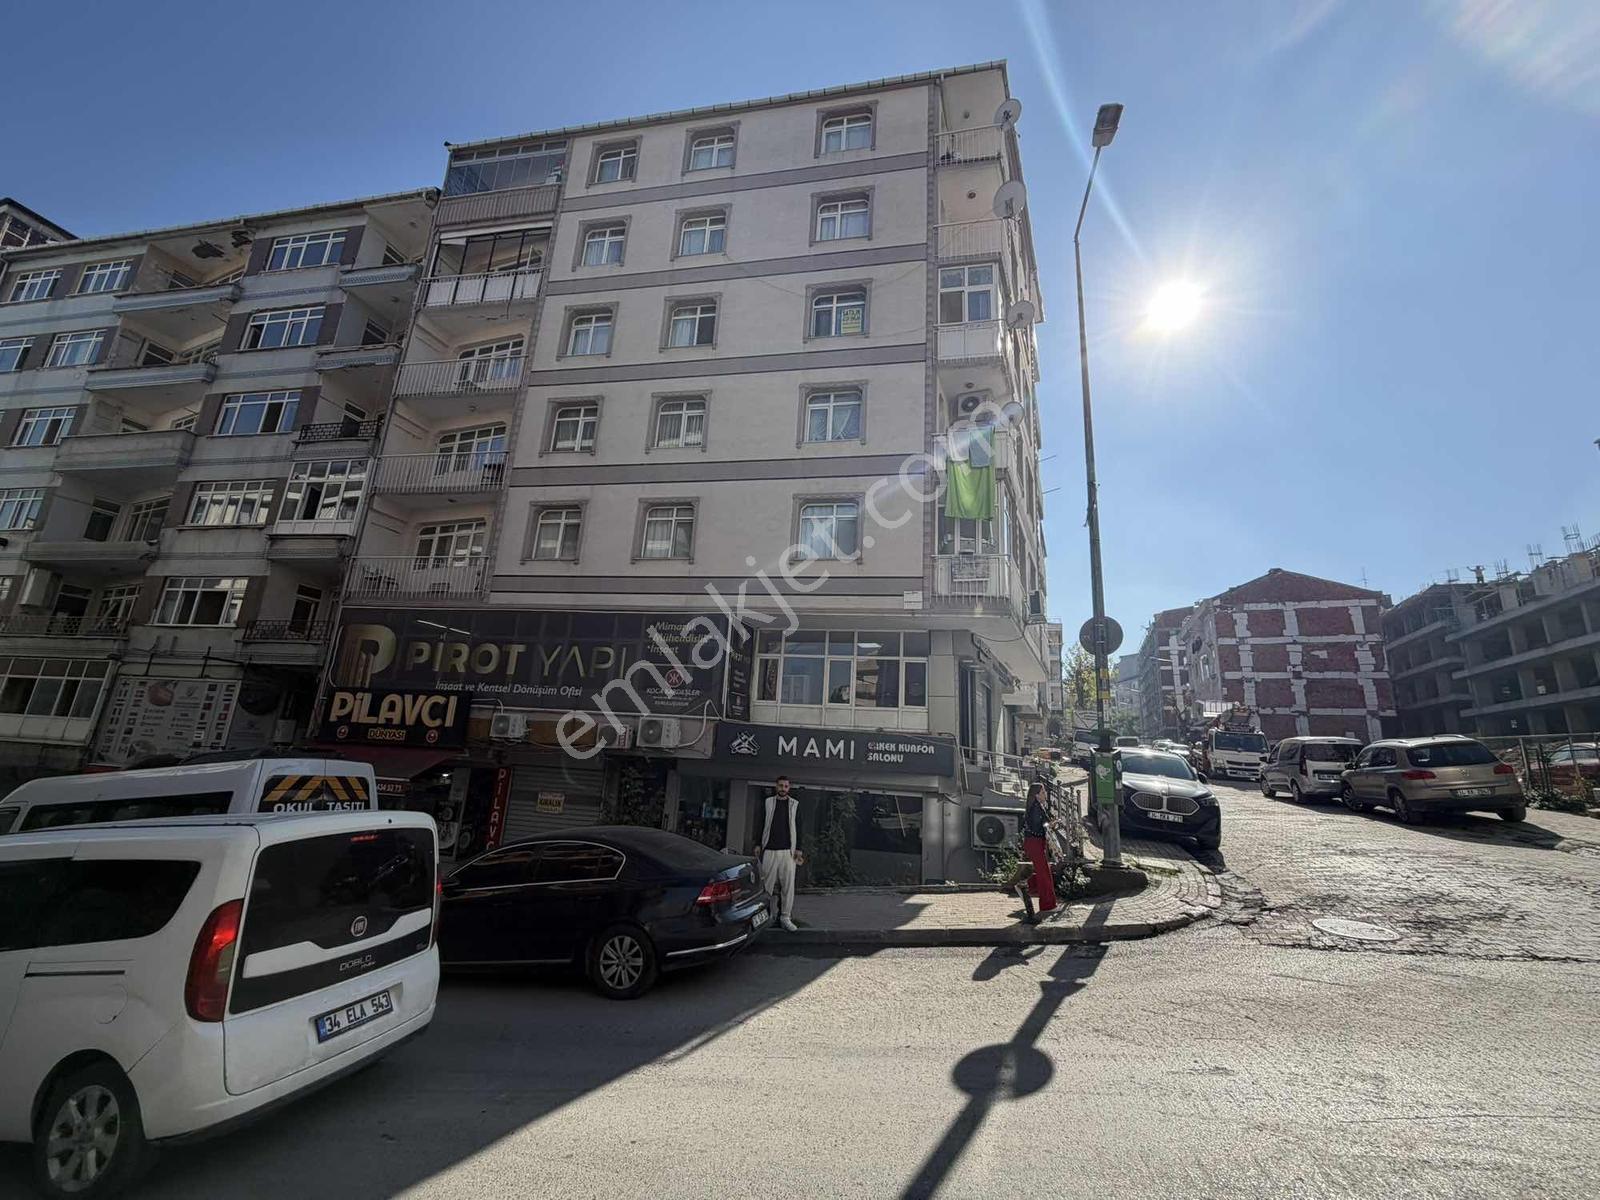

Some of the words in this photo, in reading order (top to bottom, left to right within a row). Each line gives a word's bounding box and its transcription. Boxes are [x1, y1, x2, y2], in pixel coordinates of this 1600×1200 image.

[538, 645, 626, 679] YAPI
[465, 683, 475, 692] ve
[477, 682, 511, 693] Kentsel
[513, 683, 557, 697] Dönüşüm
[559, 685, 583, 698] Ofisi
[329, 692, 458, 728] PİLAVCI
[368, 727, 406, 740] DÜNYASI
[778, 735, 855, 760] MAMI
[867, 752, 904, 763] SALONU
[326, 1014, 341, 1032] 34
[346, 1004, 367, 1024] ELA
[371, 994, 391, 1013] 543
